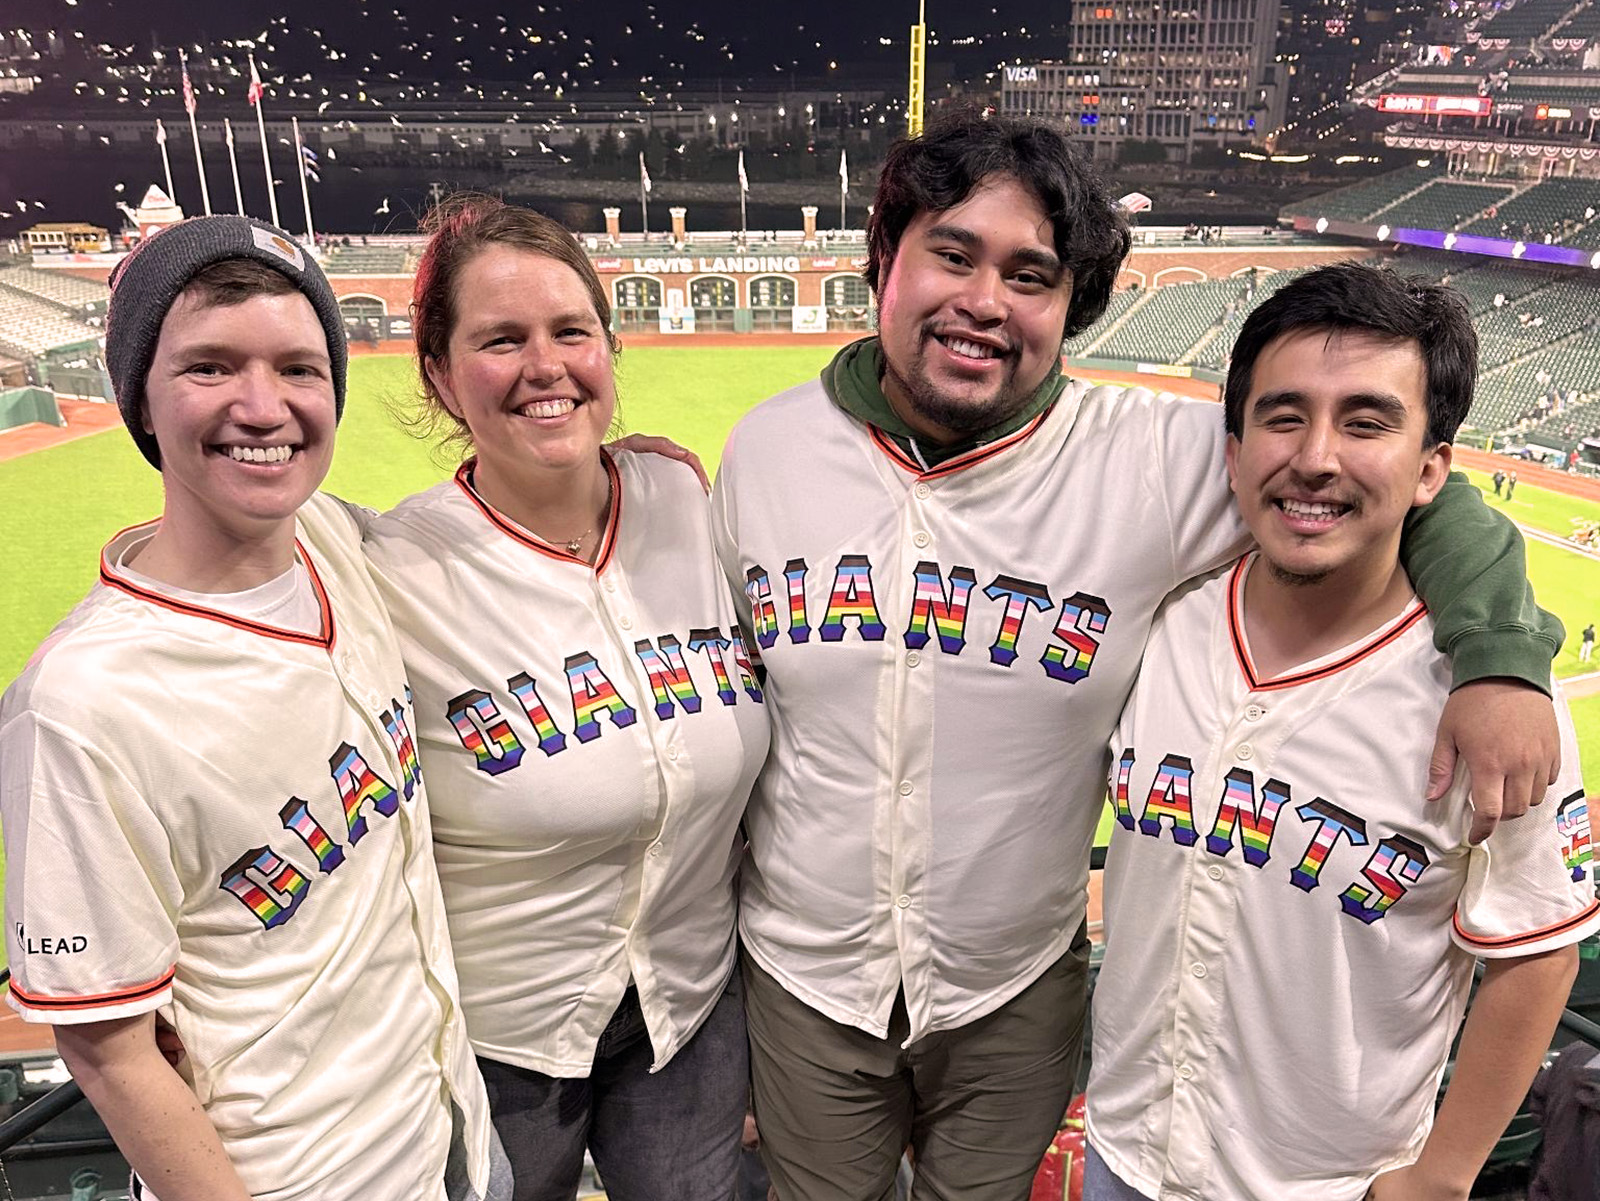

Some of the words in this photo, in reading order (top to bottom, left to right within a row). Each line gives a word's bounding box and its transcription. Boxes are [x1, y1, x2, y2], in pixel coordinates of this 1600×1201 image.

[1006, 67, 1038, 82] VISA
[699, 257, 801, 273] LANDING
[745, 554, 1112, 685] GIANTS
[446, 625, 763, 777] GIANTS
[219, 683, 422, 931] GIAN
[1108, 747, 1431, 925] IANTS
